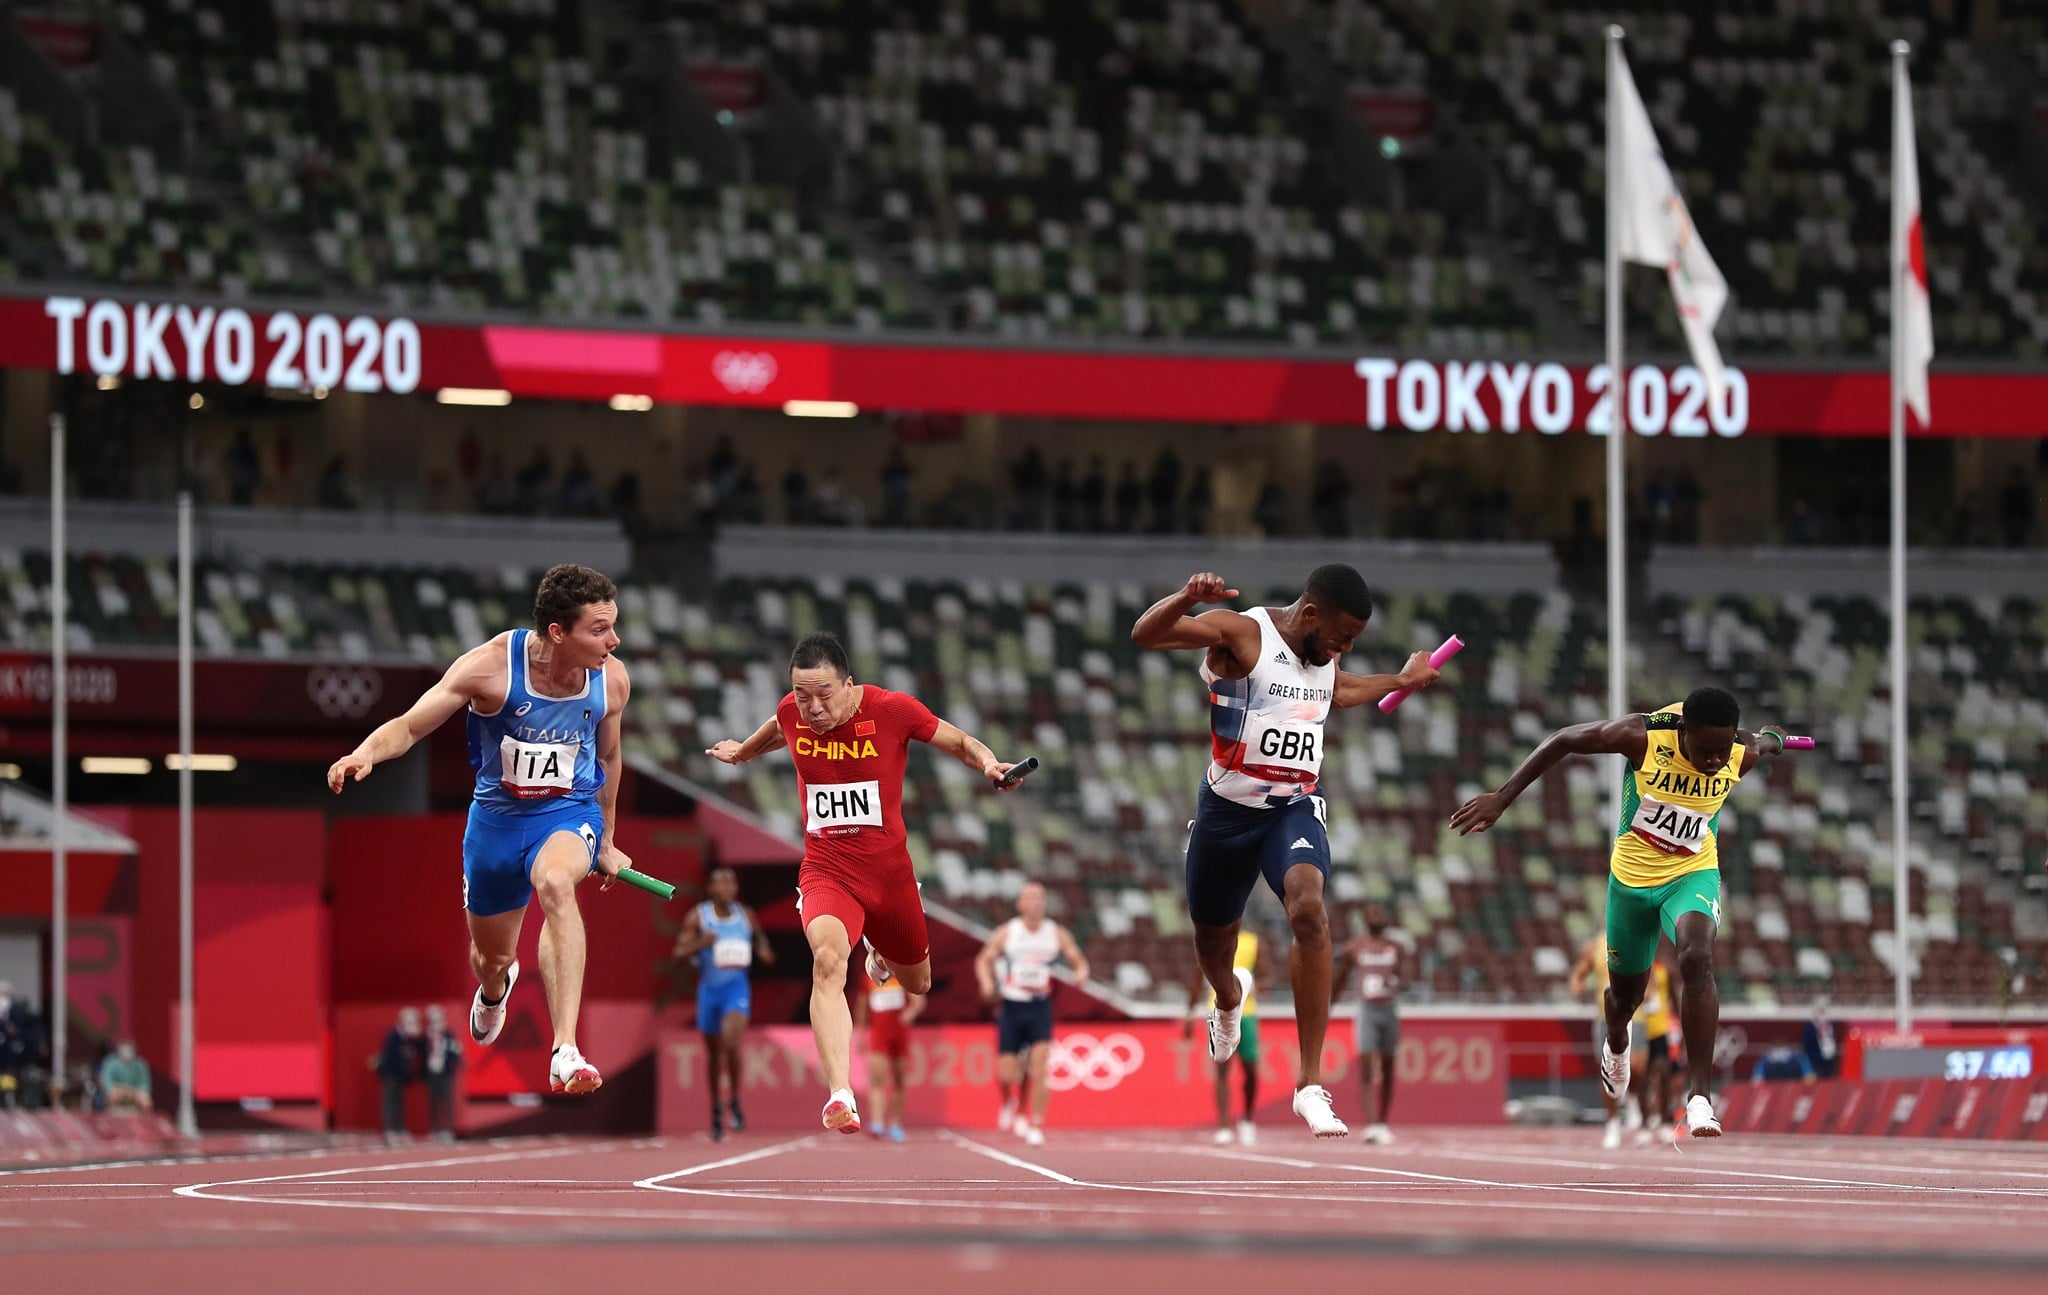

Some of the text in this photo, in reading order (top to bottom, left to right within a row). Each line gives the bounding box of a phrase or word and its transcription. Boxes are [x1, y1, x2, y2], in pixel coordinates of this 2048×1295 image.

[46, 297, 421, 393] TOKYO 2020
[1356, 359, 1750, 439] TOKYO 2020
[1268, 682, 1301, 700] GREAT
[517, 726, 580, 742] ITALIA
[795, 736, 879, 760] CHINA
[1259, 727, 1315, 762] GBR
[513, 747, 560, 779] ITA
[1646, 769, 1729, 796] JAMAICA
[815, 788, 870, 819] CHN
[1643, 804, 1704, 841] JAM
[1374, 1037, 1493, 1083] 020
